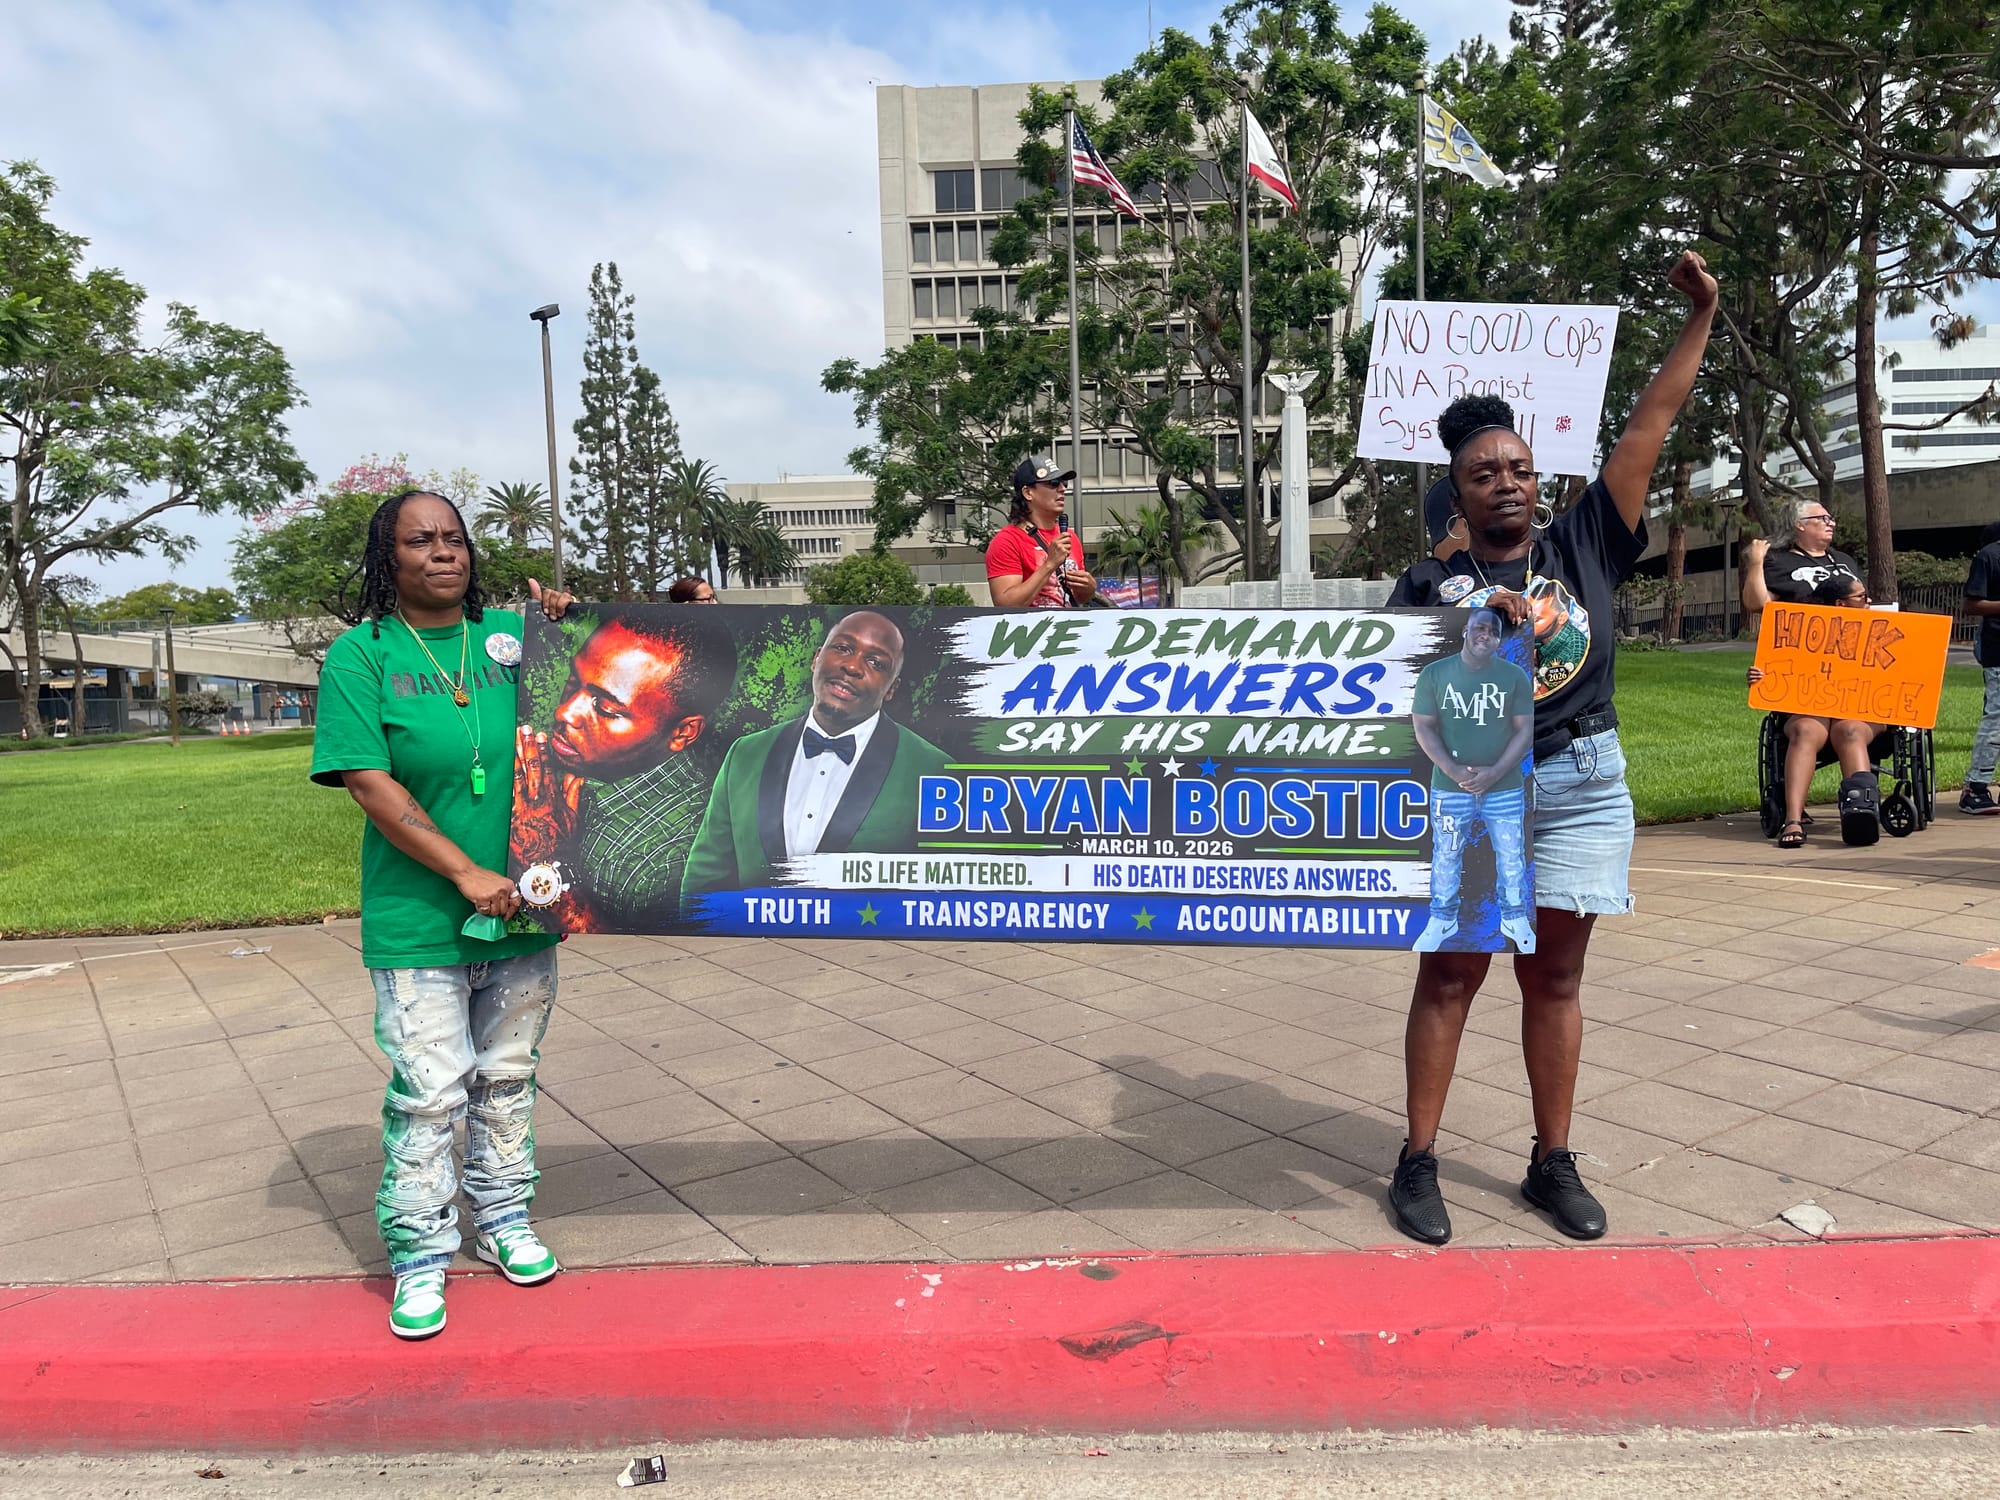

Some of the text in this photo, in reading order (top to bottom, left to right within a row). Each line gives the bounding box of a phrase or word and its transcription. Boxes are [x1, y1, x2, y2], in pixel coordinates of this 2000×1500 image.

[1381, 307, 1430, 356] NO
[1446, 309, 1533, 355] GOOD
[987, 616, 1396, 660] WE DEMAND
[1773, 609, 1904, 670] HONK
[1820, 661, 1832, 680] 4
[1000, 659, 1393, 717] ANSWERS.
[1757, 659, 1924, 721] JUSTICE
[997, 719, 1391, 756] SAY HIS NAME.
[917, 776, 1429, 840] BRYAN BOSTIC
[1082, 838, 1233, 857] MARCH 10, 2026
[842, 860, 1033, 886] HIS LIFE MATTERED.
[1093, 863, 1397, 892] HIS DEATH DESERVES ANSWERS.
[743, 897, 831, 925] TRUTH
[902, 900, 1110, 930] TRANSPARENCY
[1177, 905, 1411, 936] ACCOUNTABILITY
